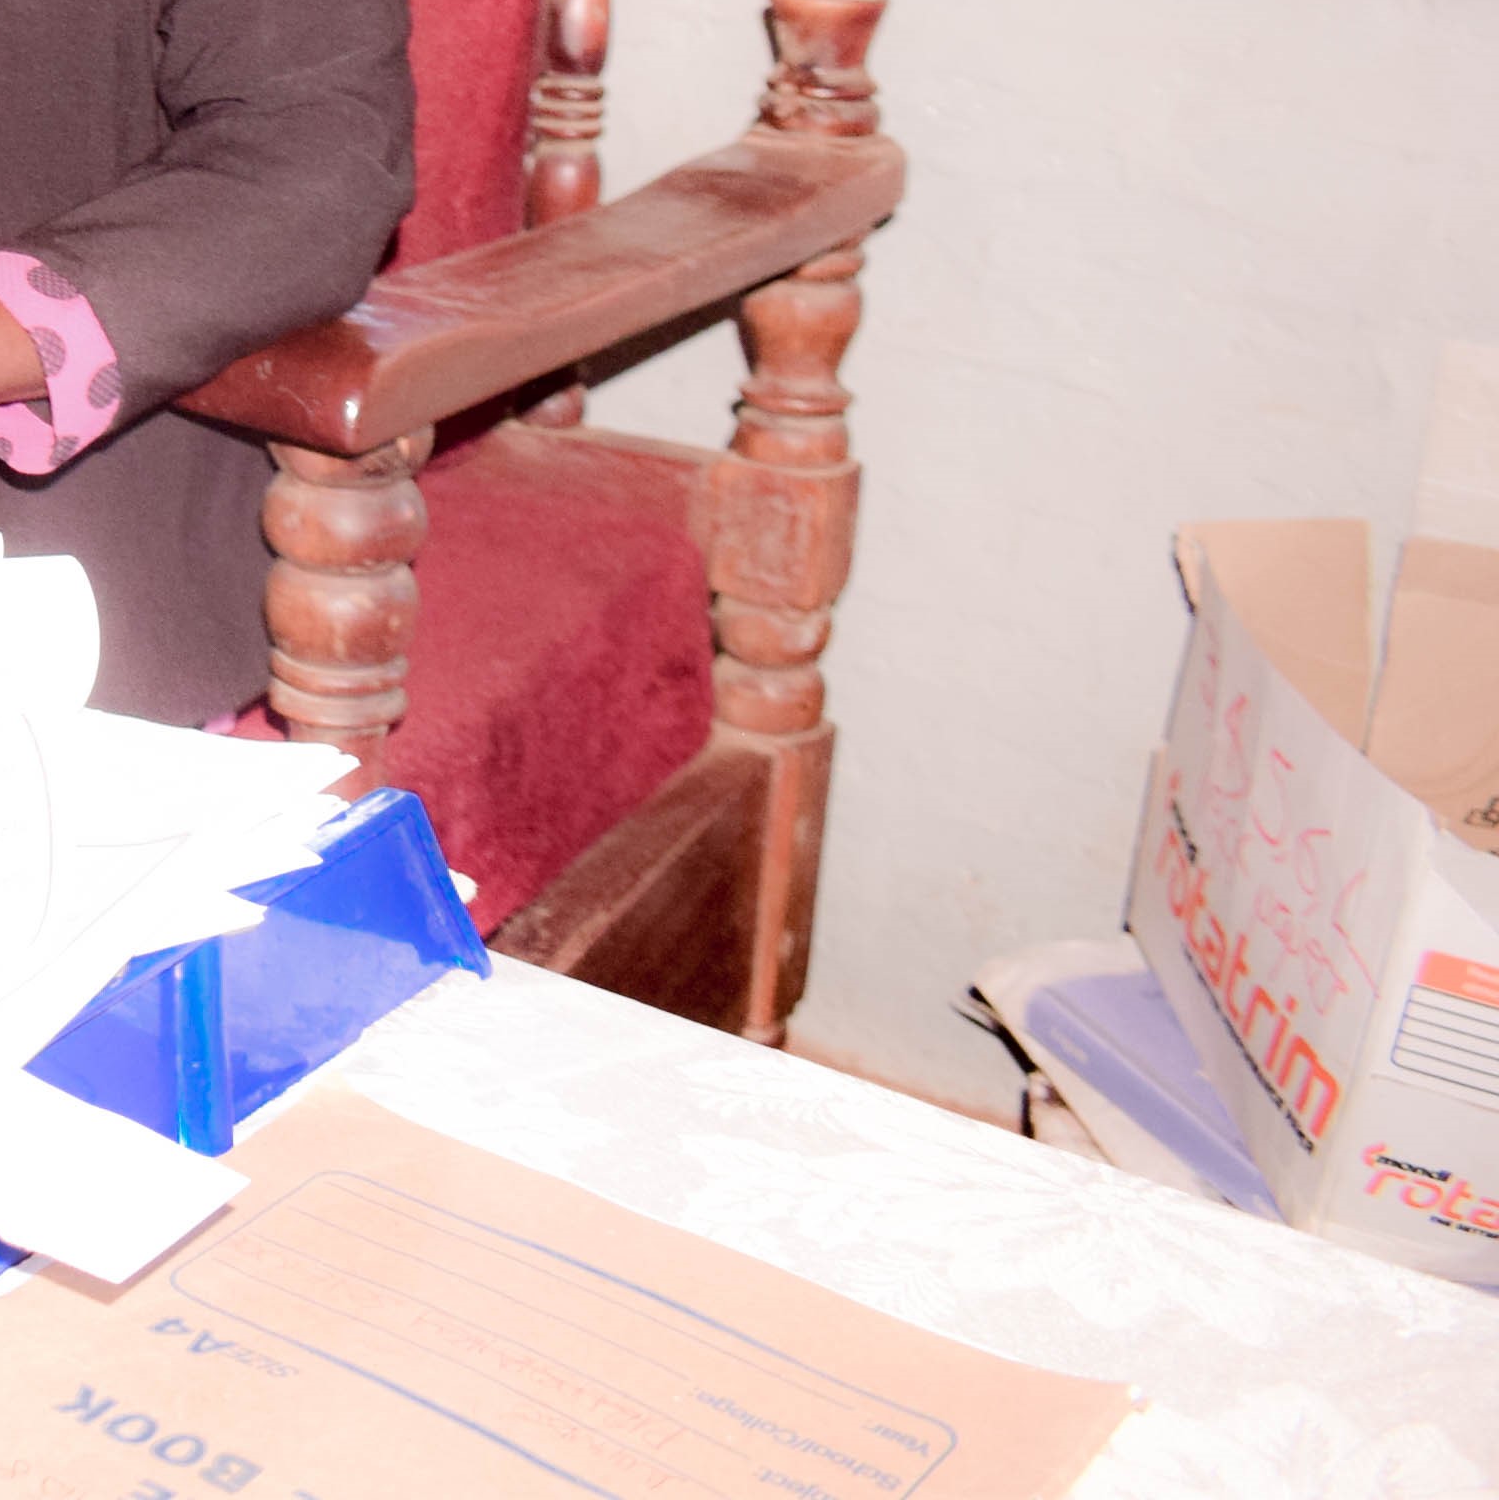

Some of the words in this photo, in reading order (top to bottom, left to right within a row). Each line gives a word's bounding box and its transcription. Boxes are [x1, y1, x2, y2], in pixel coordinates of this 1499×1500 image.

[1154, 827, 1341, 1140] rotatrim
[147, 1316, 238, 1355] A4
[51, 1383, 266, 1496] BOOK
[685, 1386, 903, 1493] School/College:
[860, 1420, 931, 1458] Year:
